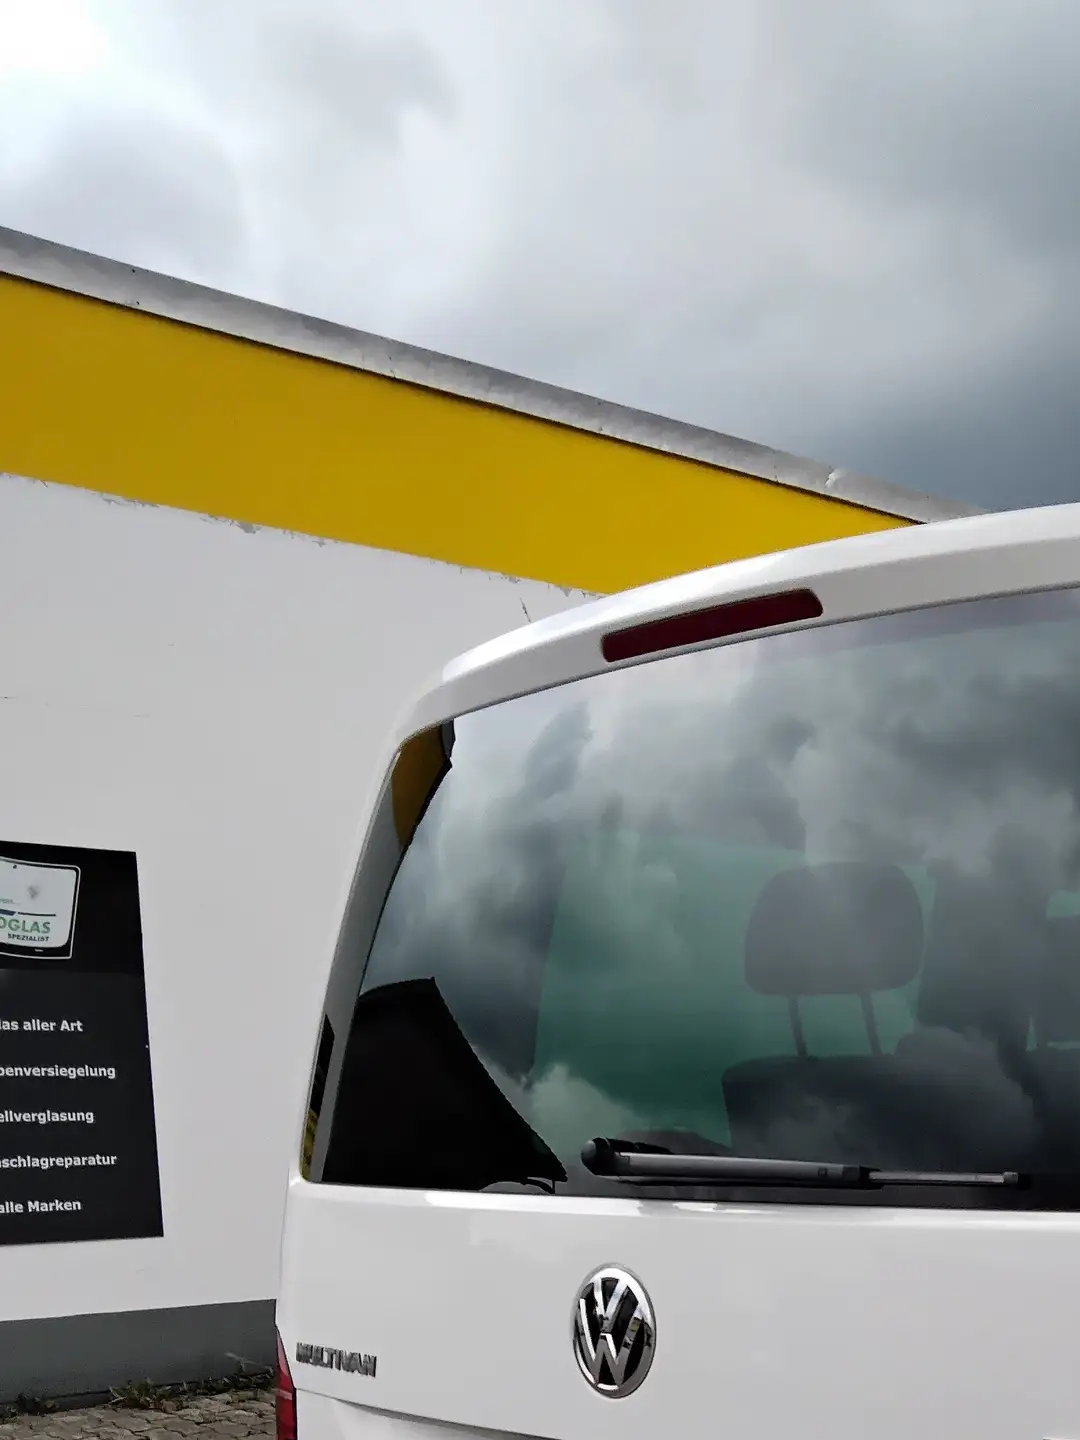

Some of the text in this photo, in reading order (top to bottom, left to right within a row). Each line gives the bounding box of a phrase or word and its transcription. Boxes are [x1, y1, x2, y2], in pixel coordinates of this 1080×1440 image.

[23, 1018, 57, 1031] aller
[60, 1020, 83, 1032] Art
[0, 1154, 117, 1170] schlagreparatur
[27, 1199, 82, 1213] Marken
[295, 1342, 377, 1378] MULTIVAN
